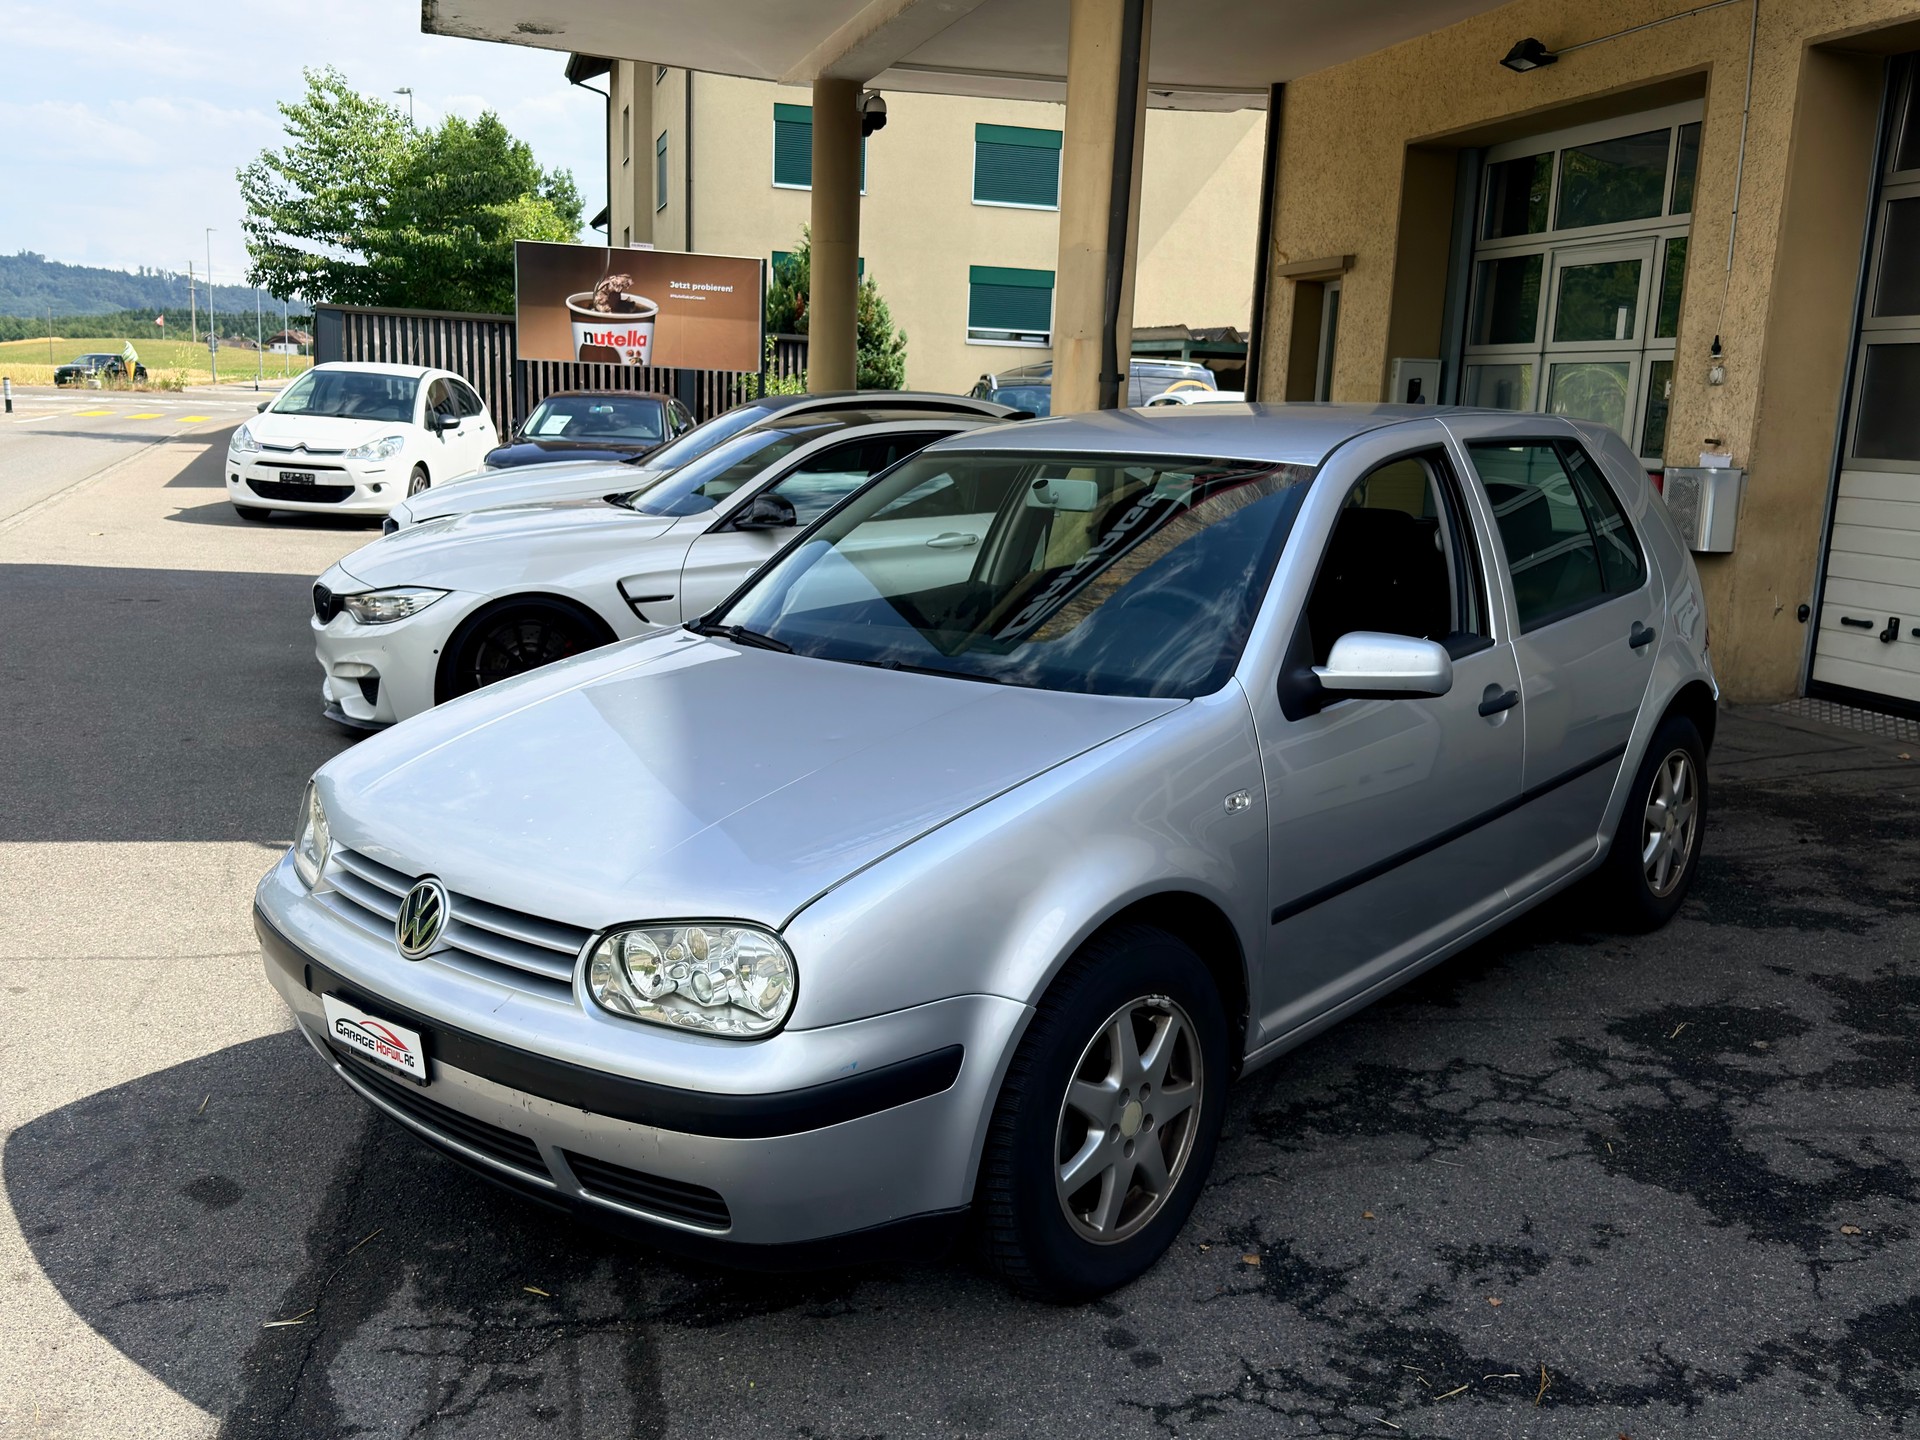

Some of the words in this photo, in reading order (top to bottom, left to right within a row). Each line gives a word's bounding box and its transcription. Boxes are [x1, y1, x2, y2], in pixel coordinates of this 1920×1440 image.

[670, 281, 690, 290] Jetzt
[692, 283, 733, 293] probieren!
[583, 330, 648, 348] nutella
[335, 1021, 375, 1051] GARAGE
[375, 1039, 404, 1063] HOFWIL
[404, 1053, 415, 1068] AG
